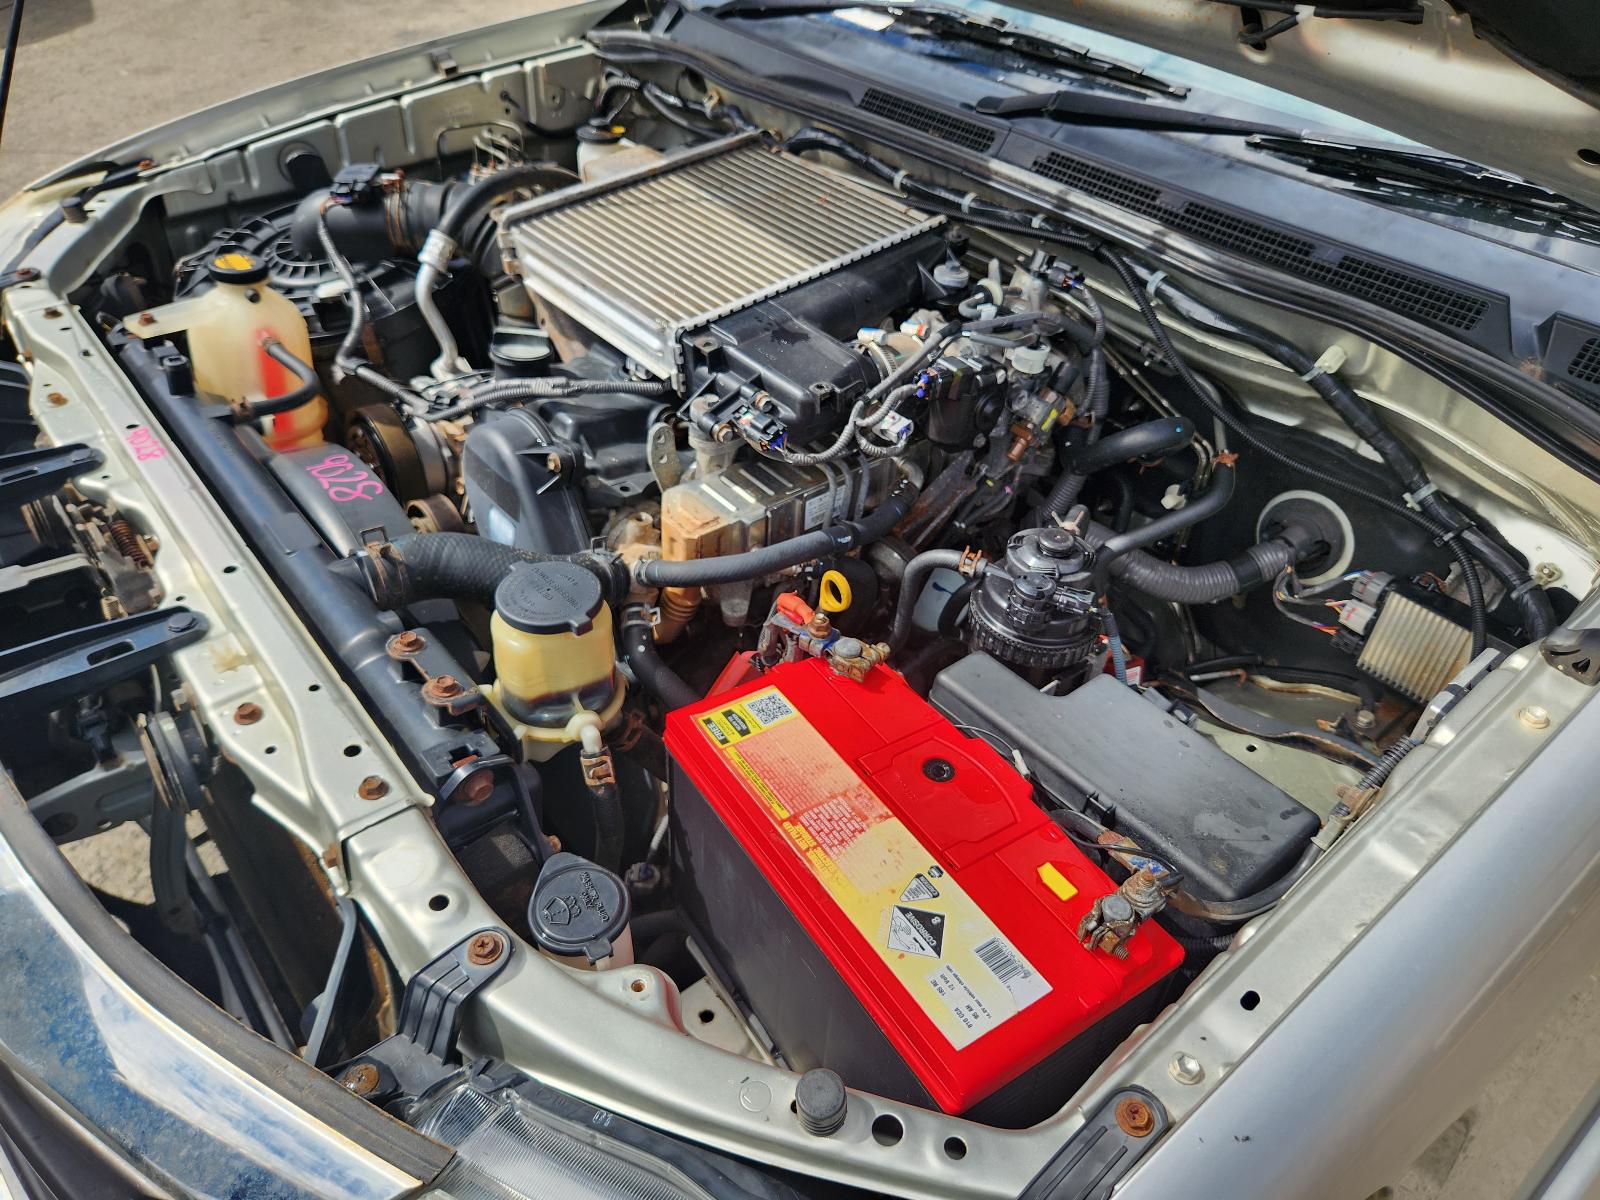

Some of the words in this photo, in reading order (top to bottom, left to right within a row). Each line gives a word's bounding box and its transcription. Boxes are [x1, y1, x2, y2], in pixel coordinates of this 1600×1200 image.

[706, 721, 725, 740] FREE
[904, 910, 937, 947] CORROSIVE
[930, 914, 942, 926] 8
